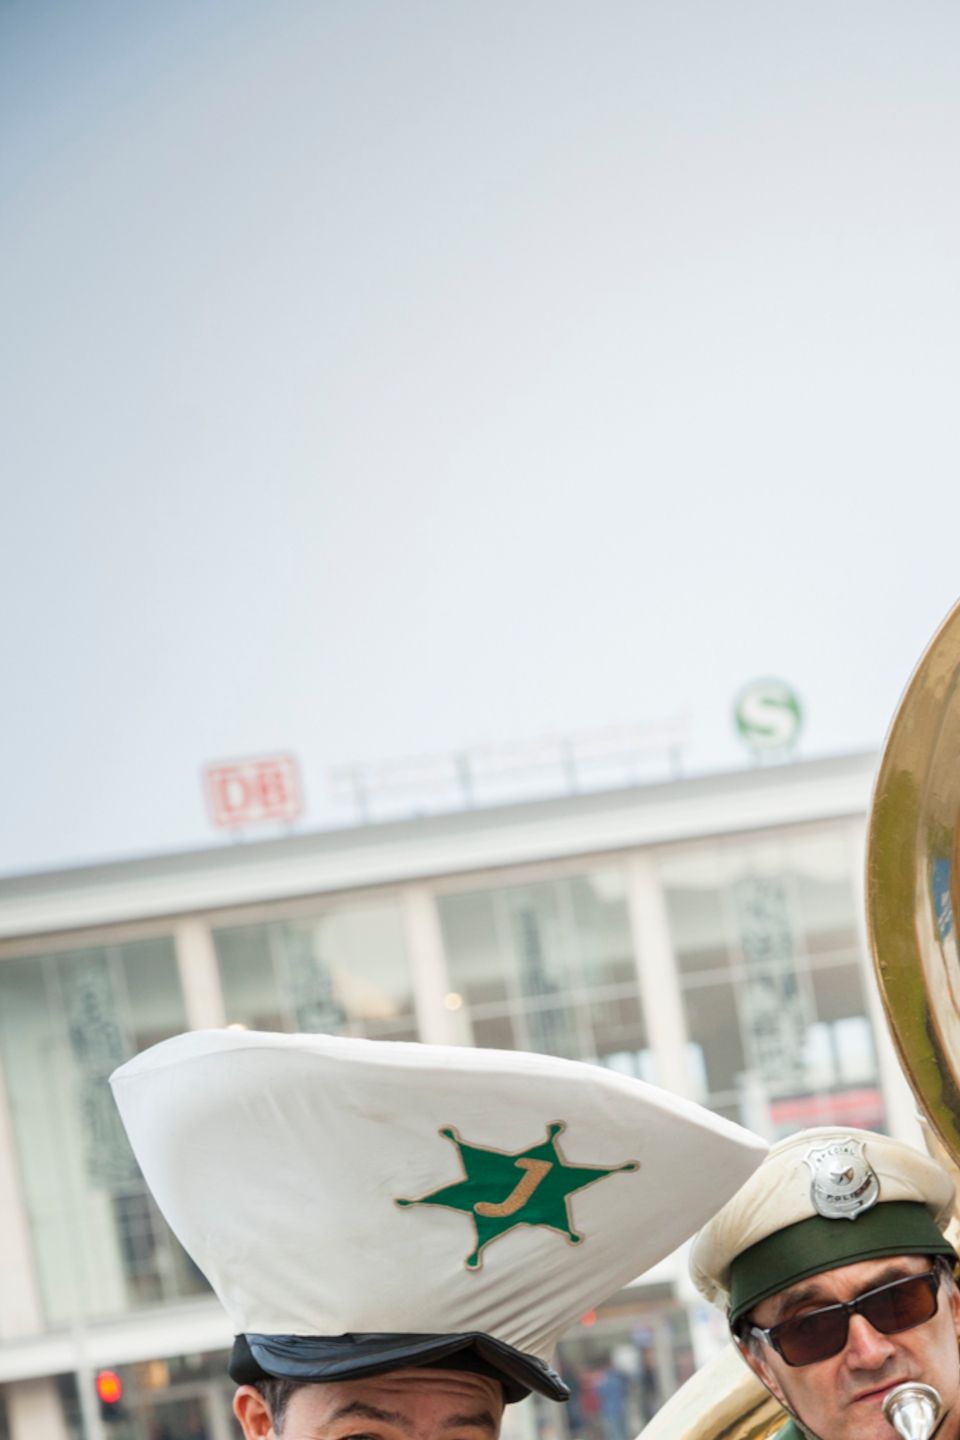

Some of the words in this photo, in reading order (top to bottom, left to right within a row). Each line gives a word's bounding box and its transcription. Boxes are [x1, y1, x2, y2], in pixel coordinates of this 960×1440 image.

[741, 683, 797, 746] S
[217, 767, 289, 815] DB
[474, 1158, 553, 1217] J
